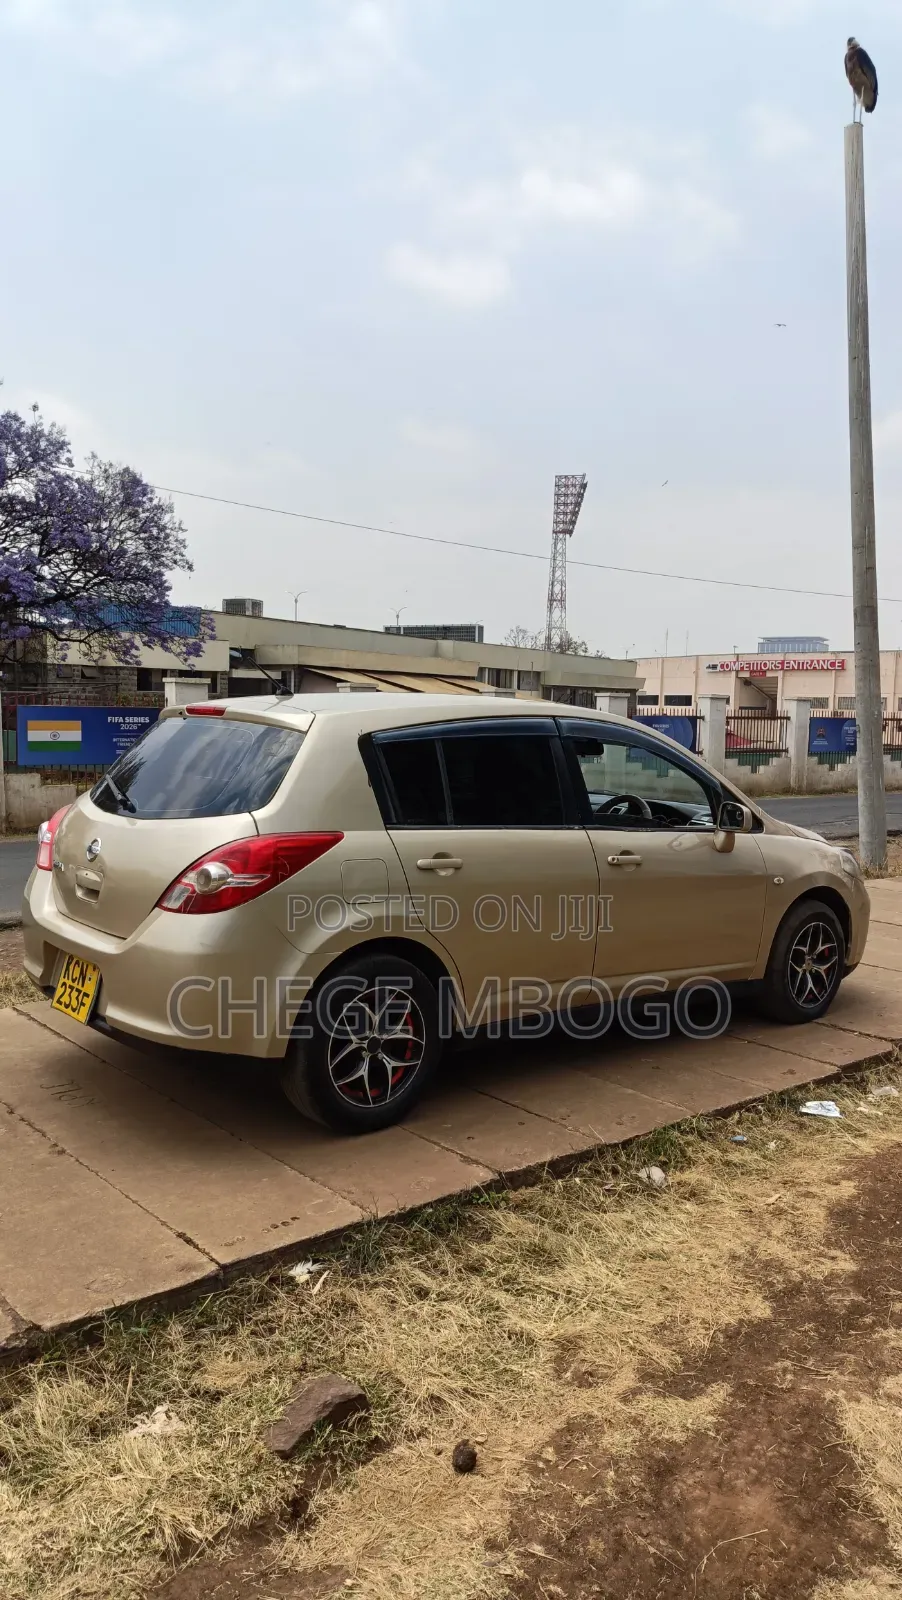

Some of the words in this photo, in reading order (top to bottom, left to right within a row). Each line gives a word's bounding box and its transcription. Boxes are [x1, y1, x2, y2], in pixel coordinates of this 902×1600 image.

[719, 660, 782, 671] COMPETITORS
[784, 659, 843, 670] ENTRANCE
[63, 954, 88, 987] KCN
[56, 981, 90, 1015] 233F
